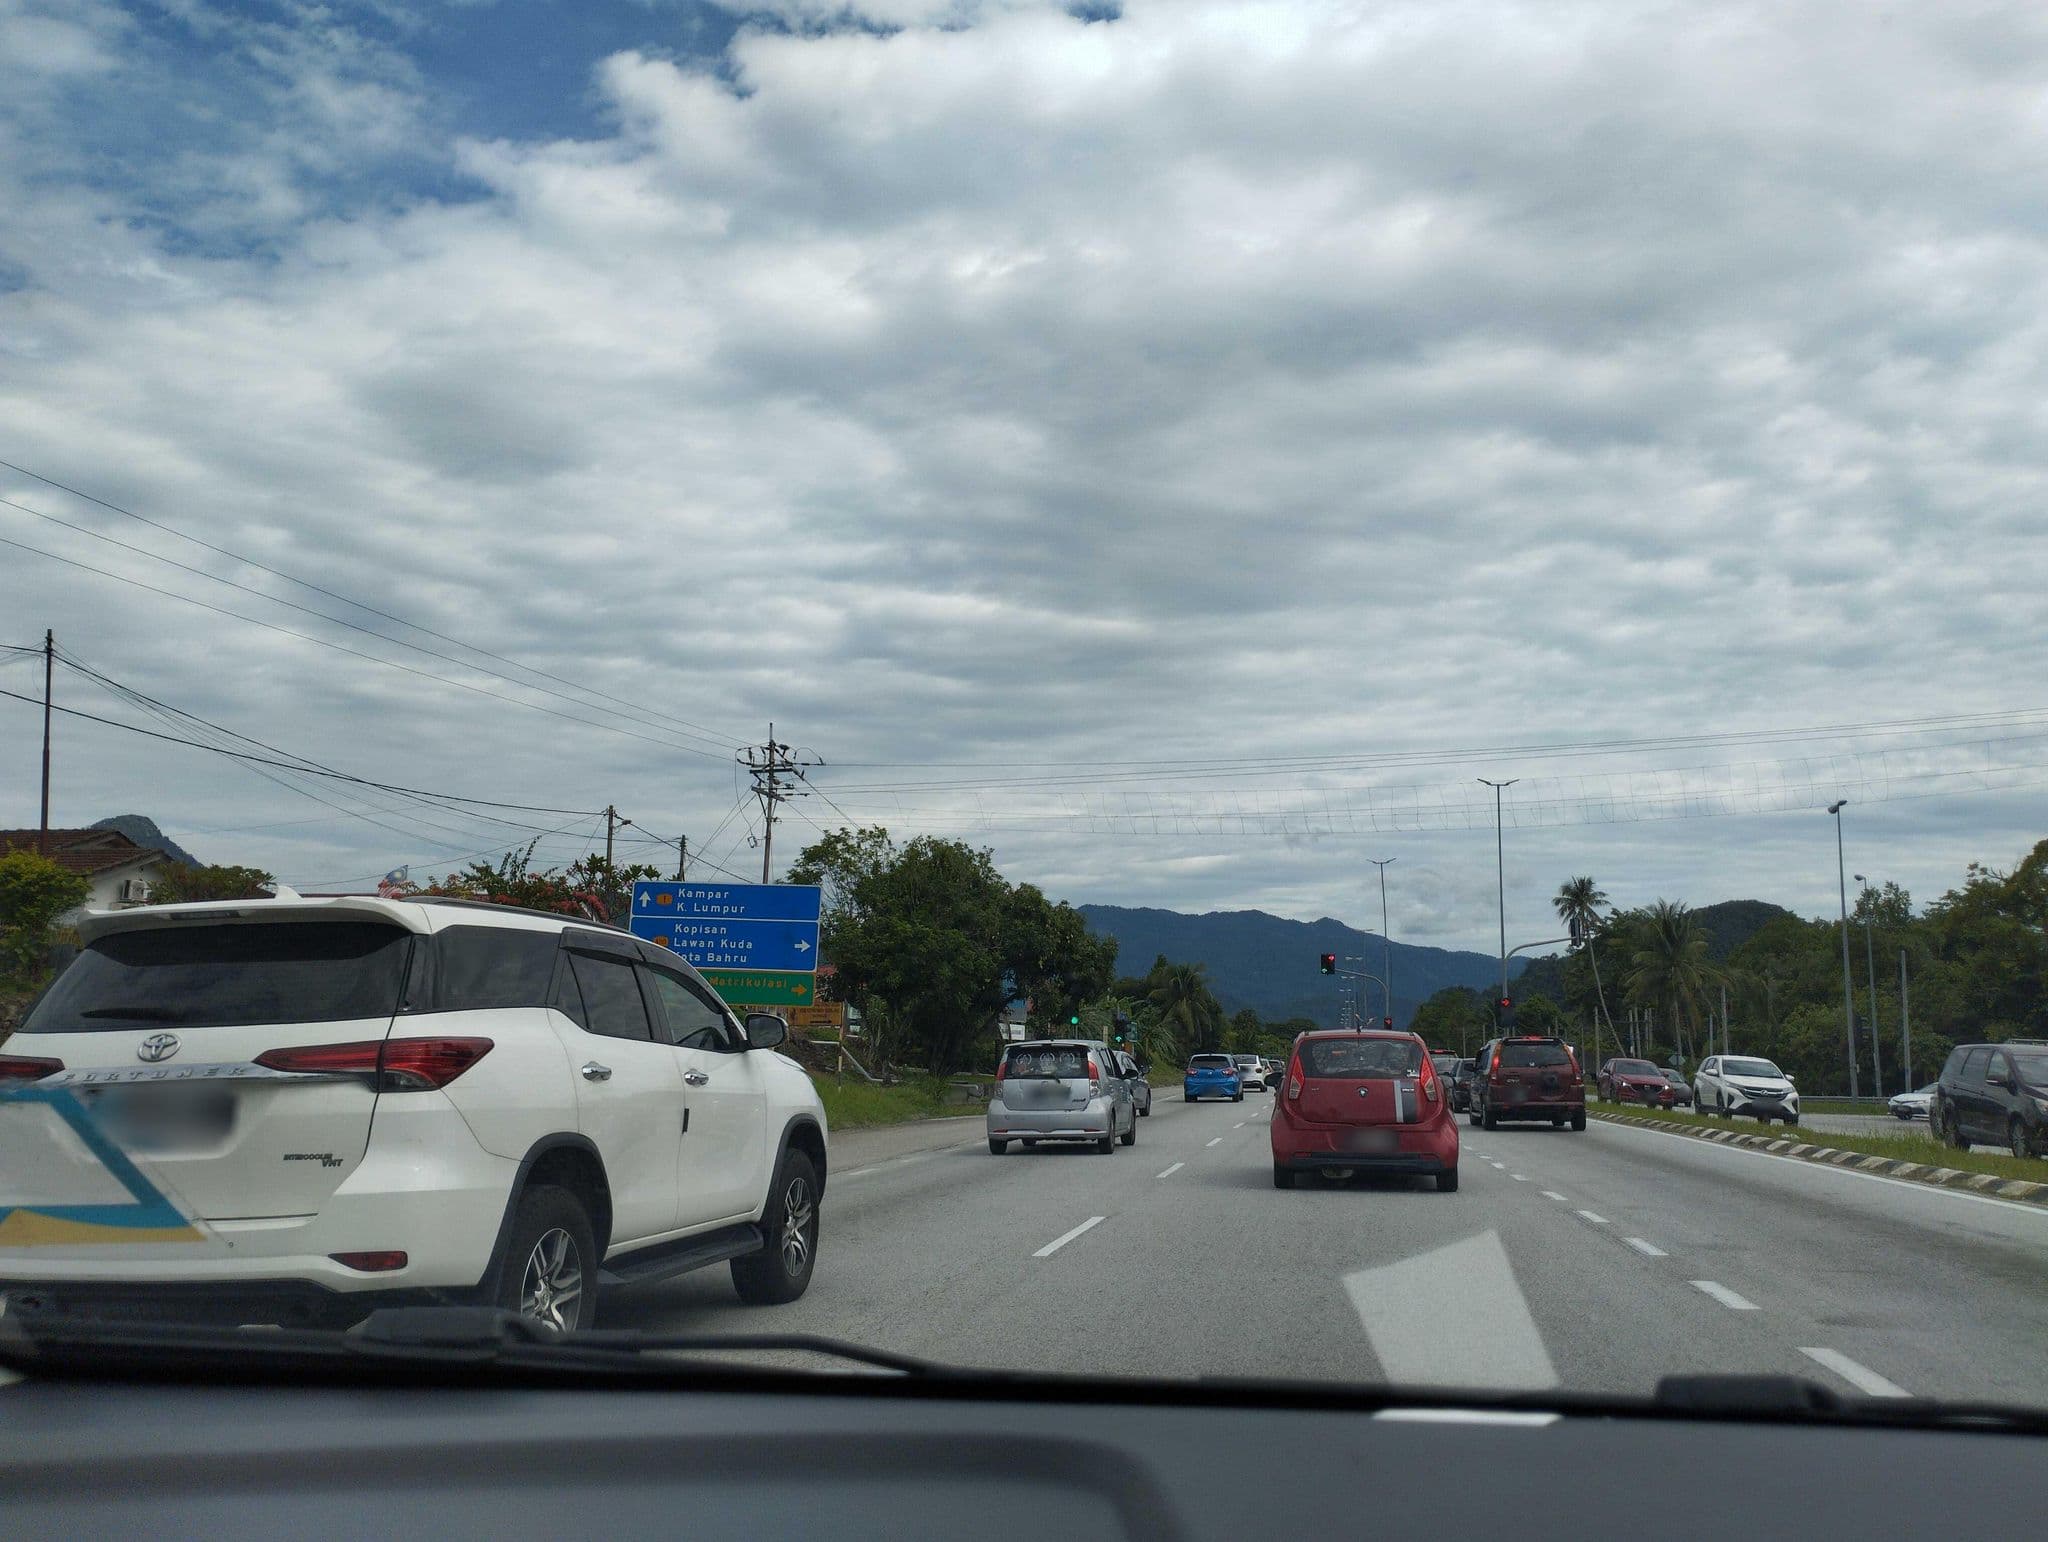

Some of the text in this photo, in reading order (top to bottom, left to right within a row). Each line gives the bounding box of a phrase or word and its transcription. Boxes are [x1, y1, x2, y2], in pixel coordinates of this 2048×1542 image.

[678, 888, 729, 900] Kampar
[677, 902, 745, 914] K. Lumpur
[675, 923, 727, 935] Kopisan
[674, 937, 714, 948] Lawan
[720, 938, 753, 949] Kuda
[676, 951, 747, 963] ota Bahru
[64, 1067, 246, 1082] FORTUNER
